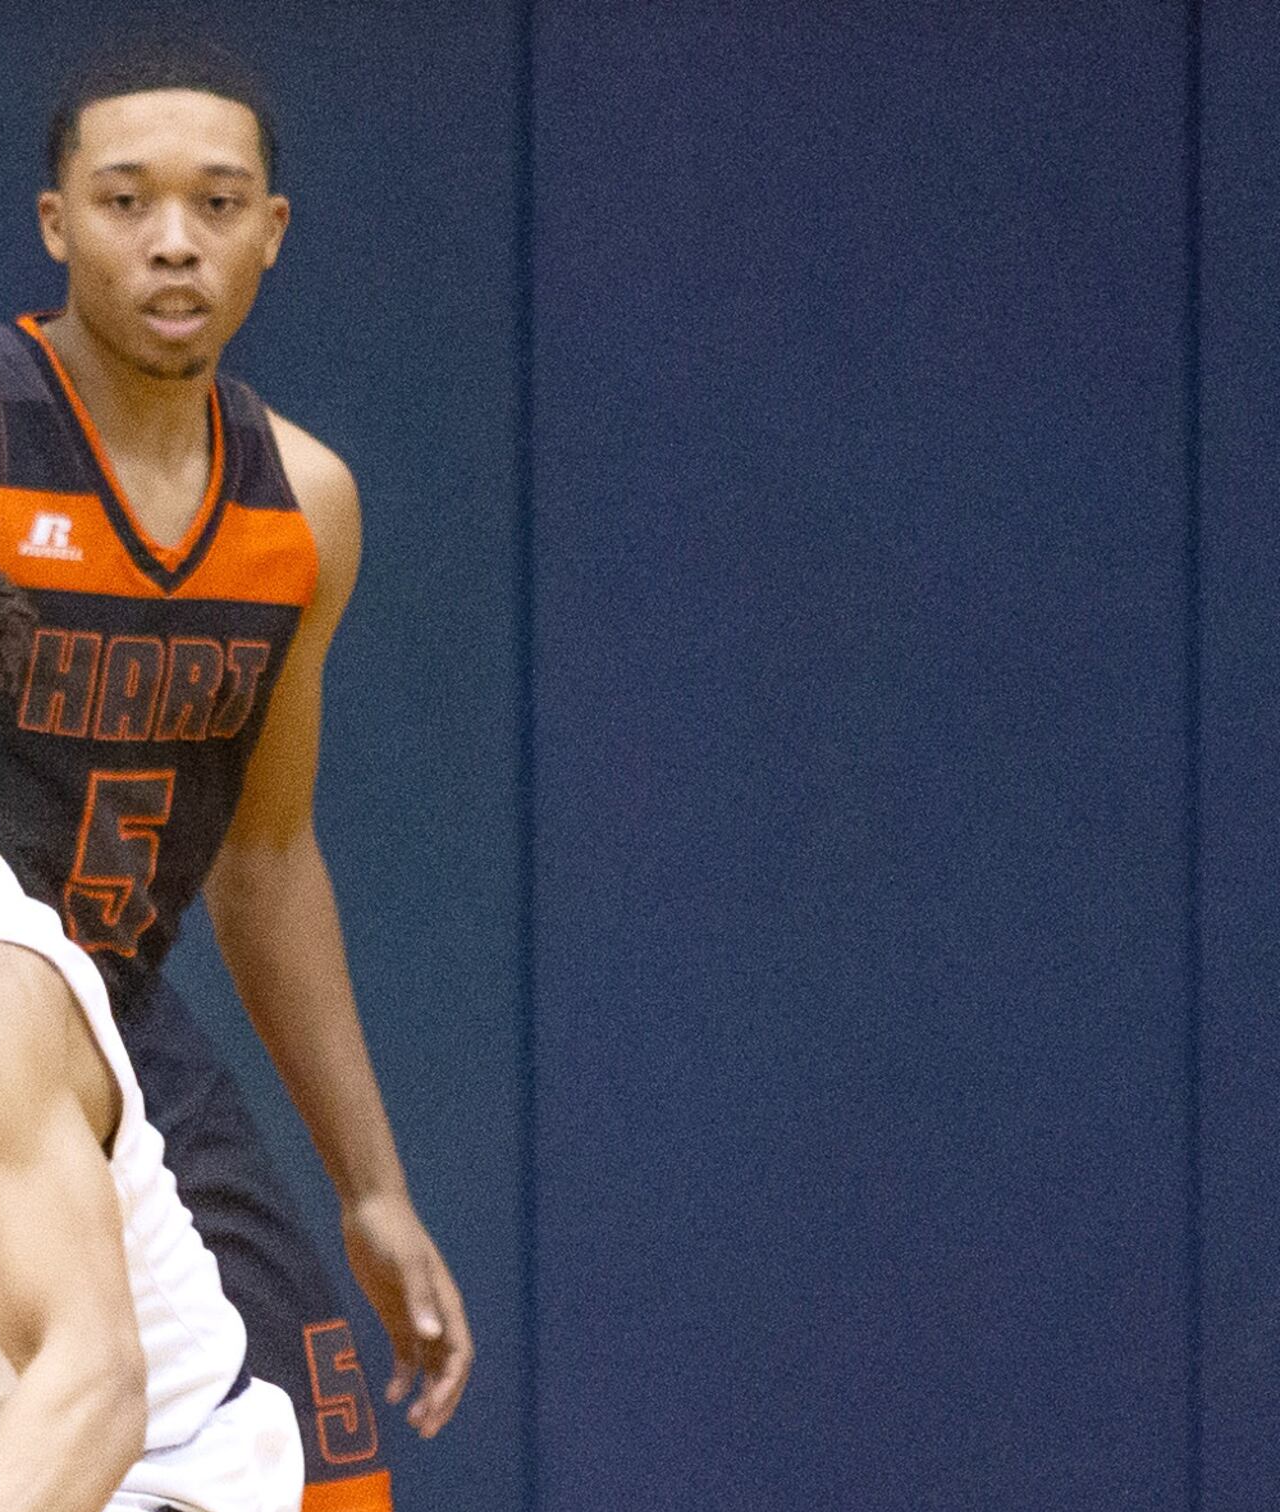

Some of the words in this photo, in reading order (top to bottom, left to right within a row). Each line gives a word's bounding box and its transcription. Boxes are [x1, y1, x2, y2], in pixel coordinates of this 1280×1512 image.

[18, 629, 271, 742] HART
[64, 769, 176, 957] 5
[303, 1318, 378, 1464] 5
